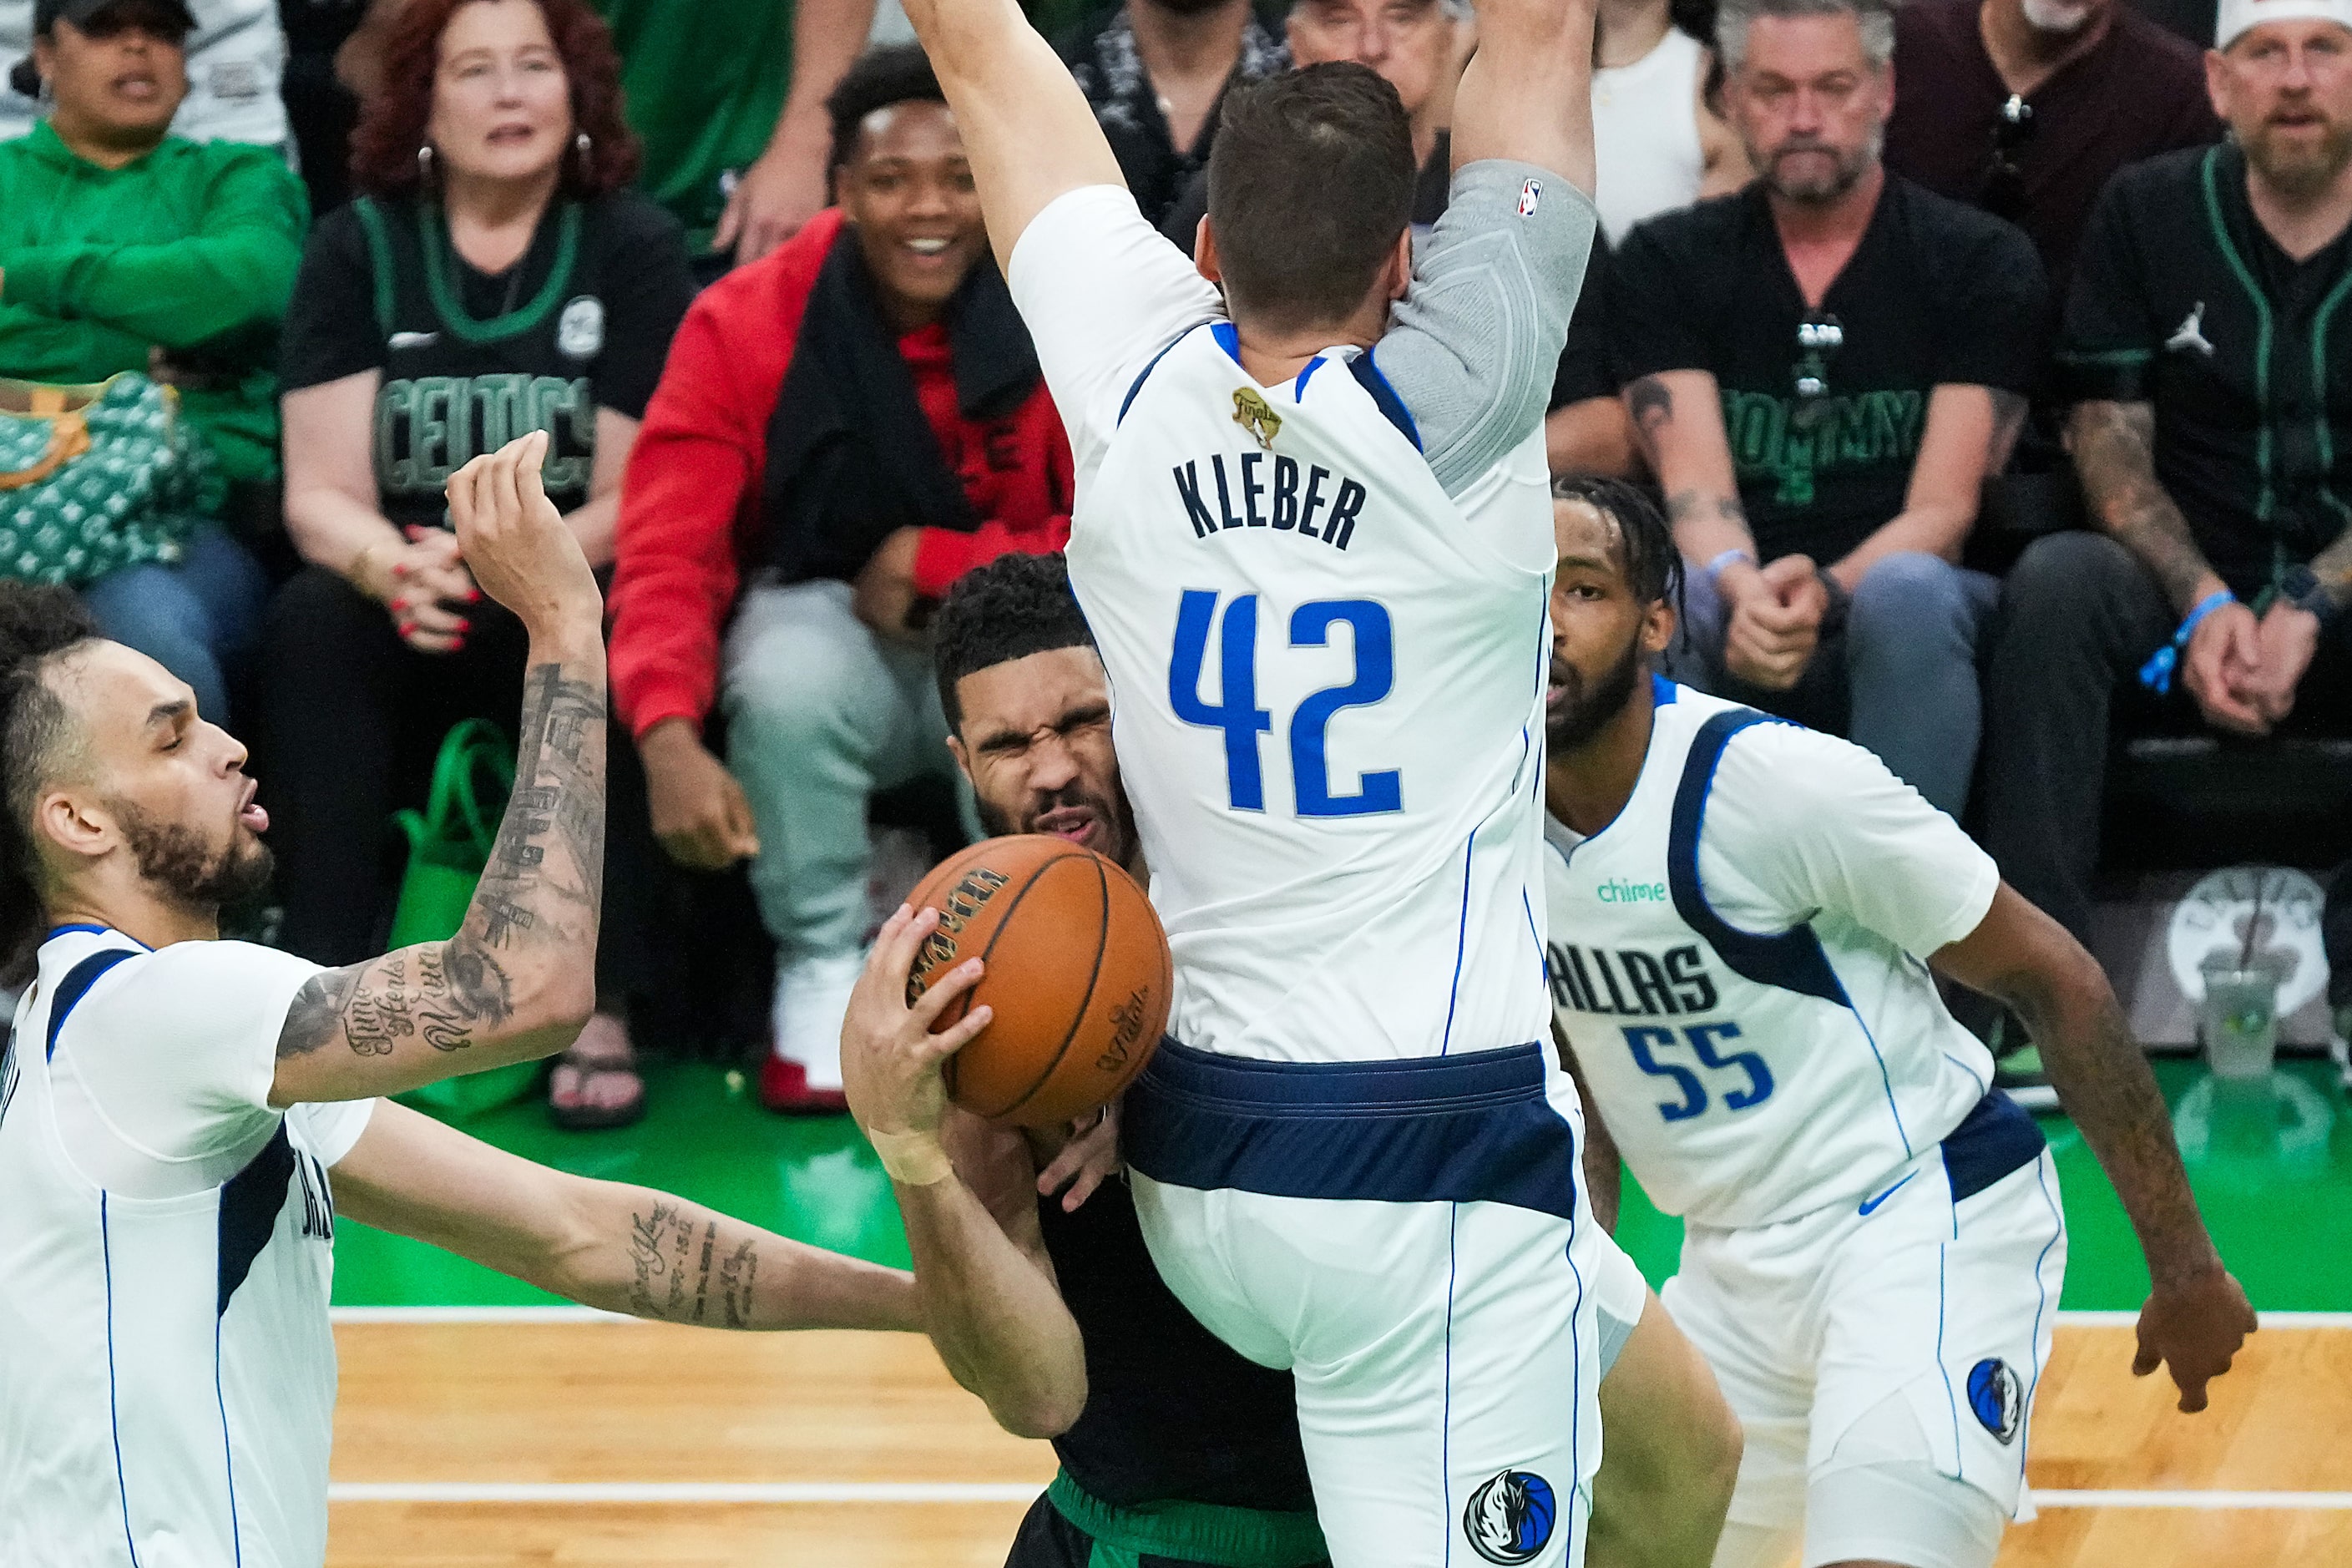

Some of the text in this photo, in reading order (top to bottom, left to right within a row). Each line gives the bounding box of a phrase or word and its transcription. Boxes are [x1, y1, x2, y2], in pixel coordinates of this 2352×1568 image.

[1172, 452, 1367, 551] KLEBER
[1167, 586, 1406, 820] 42
[1597, 878, 1667, 903] chime
[1546, 940, 1720, 1015] ALLAS
[1620, 1021, 1774, 1123] 55
